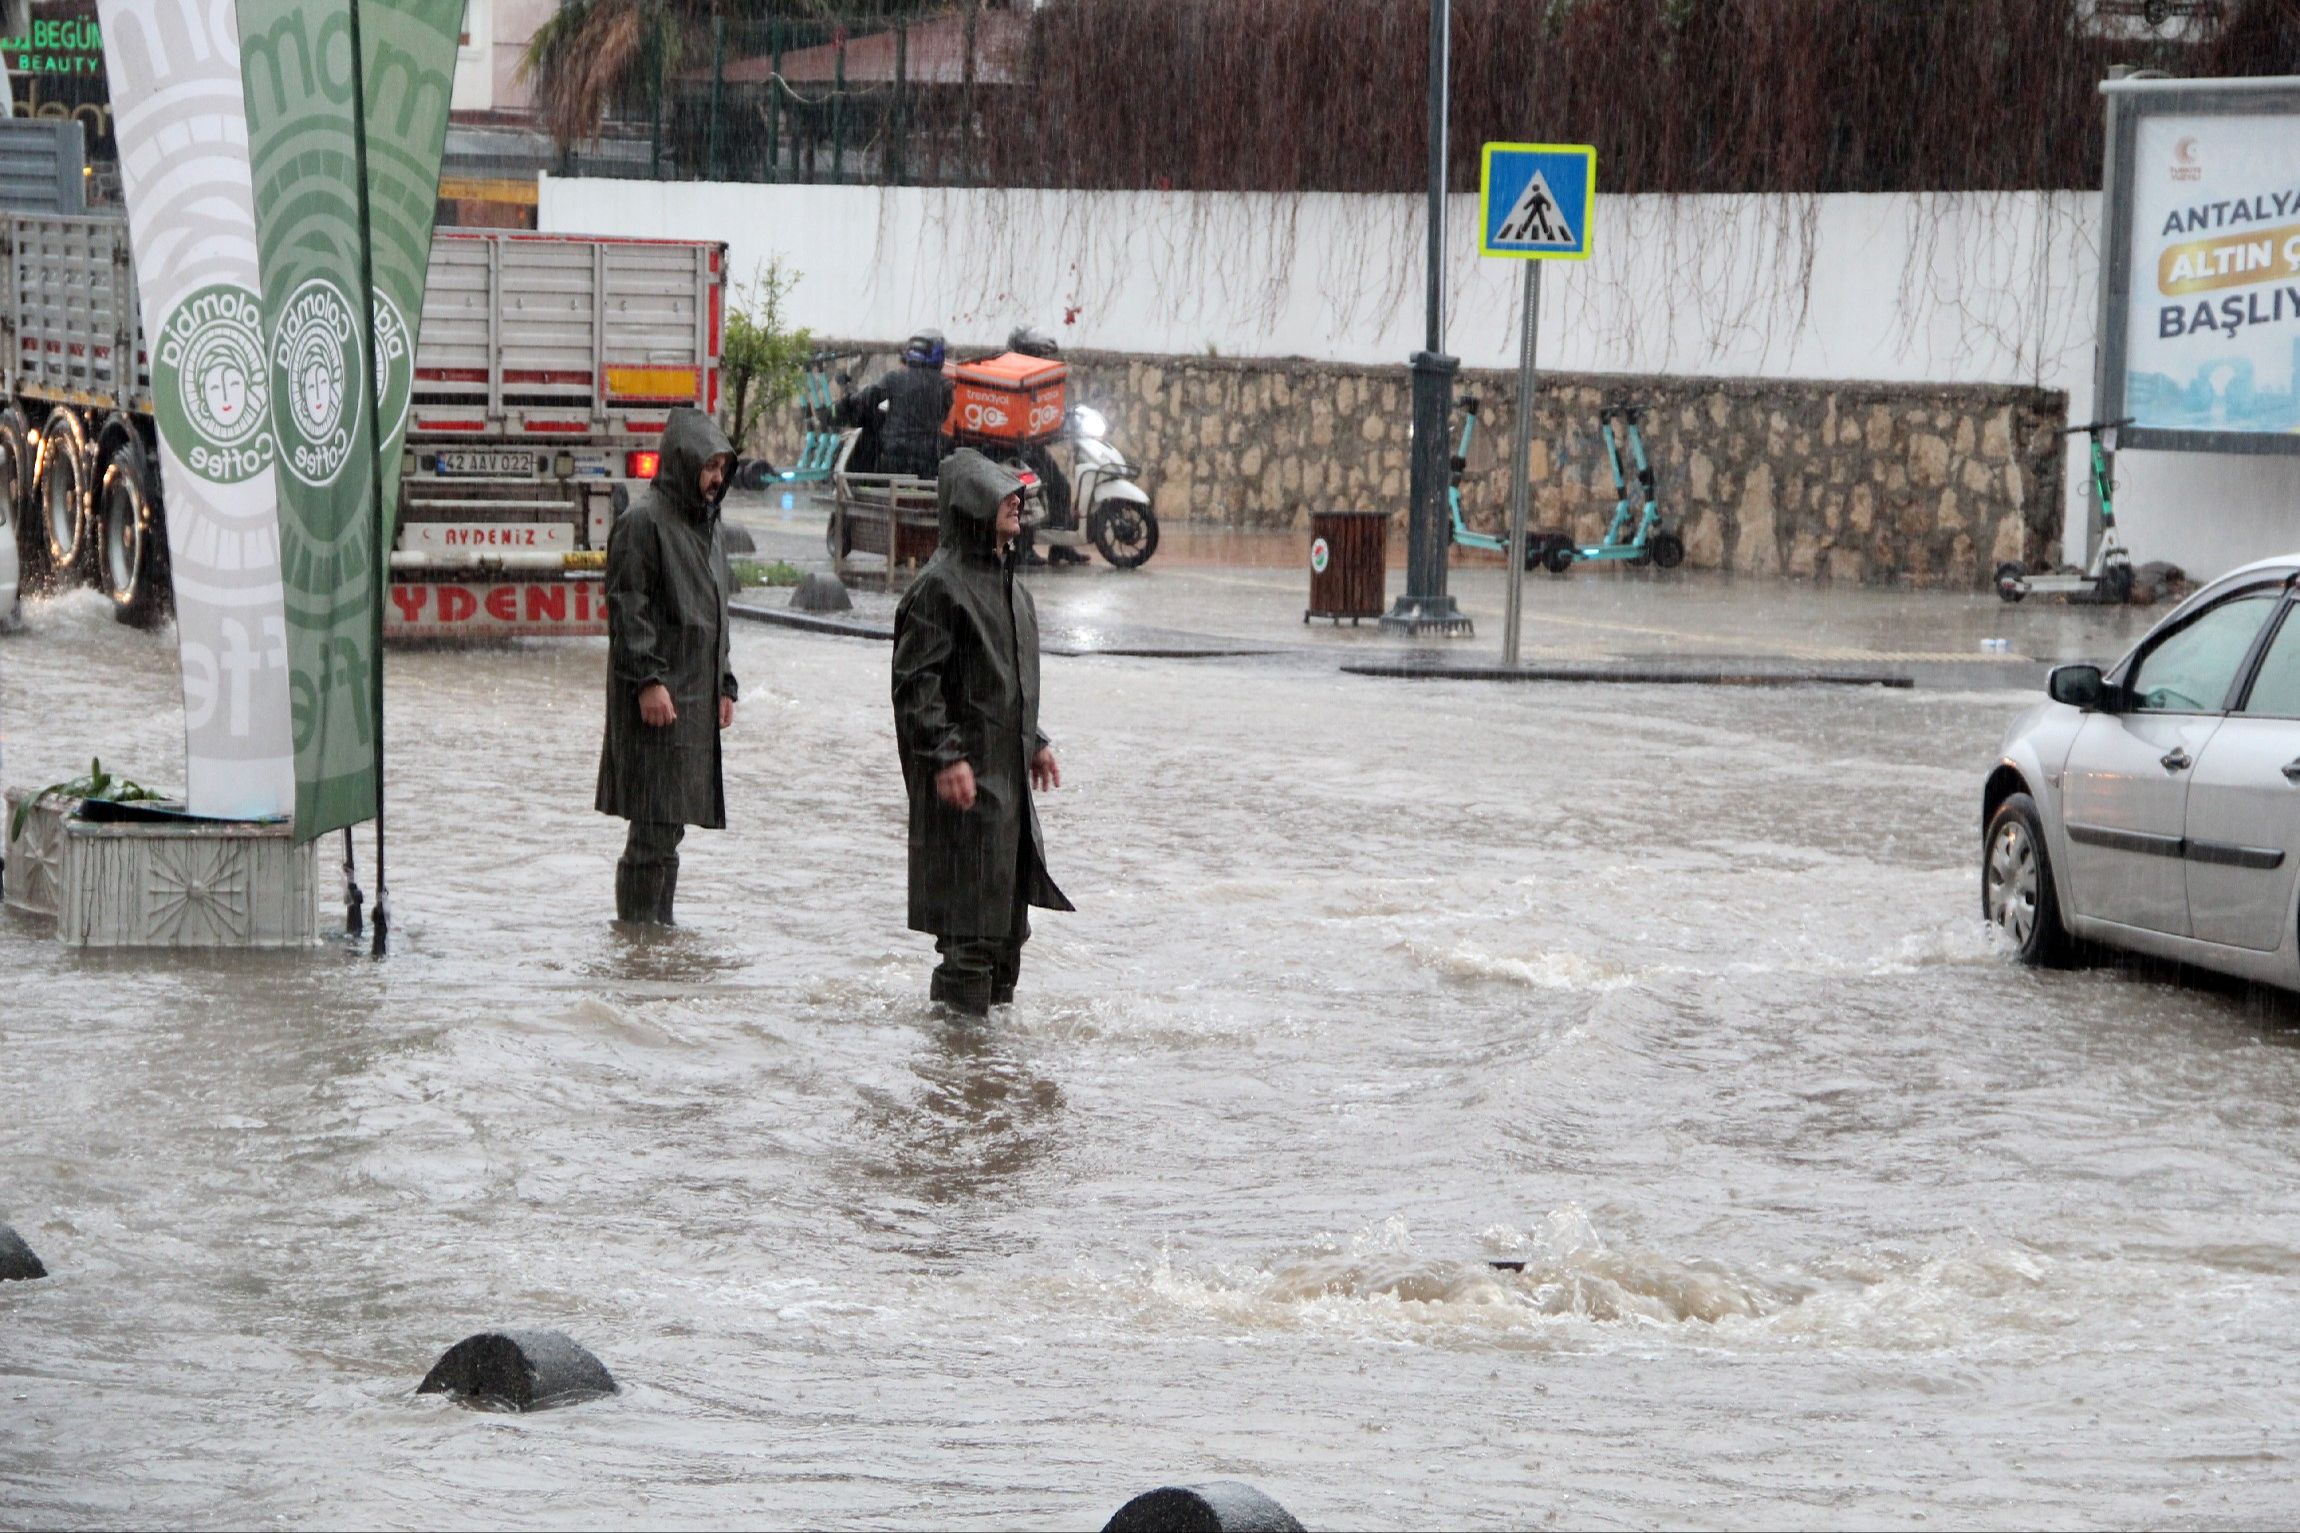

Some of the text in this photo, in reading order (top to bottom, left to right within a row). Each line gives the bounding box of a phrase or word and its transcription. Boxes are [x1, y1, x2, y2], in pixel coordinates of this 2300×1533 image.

[19, 54, 98, 73] BEAUTY
[2169, 240, 2272, 283] ALTIN
[967, 390, 1009, 406] trendyol
[446, 455, 529, 471] 42 AAV 022
[391, 582, 609, 622] YDENi
